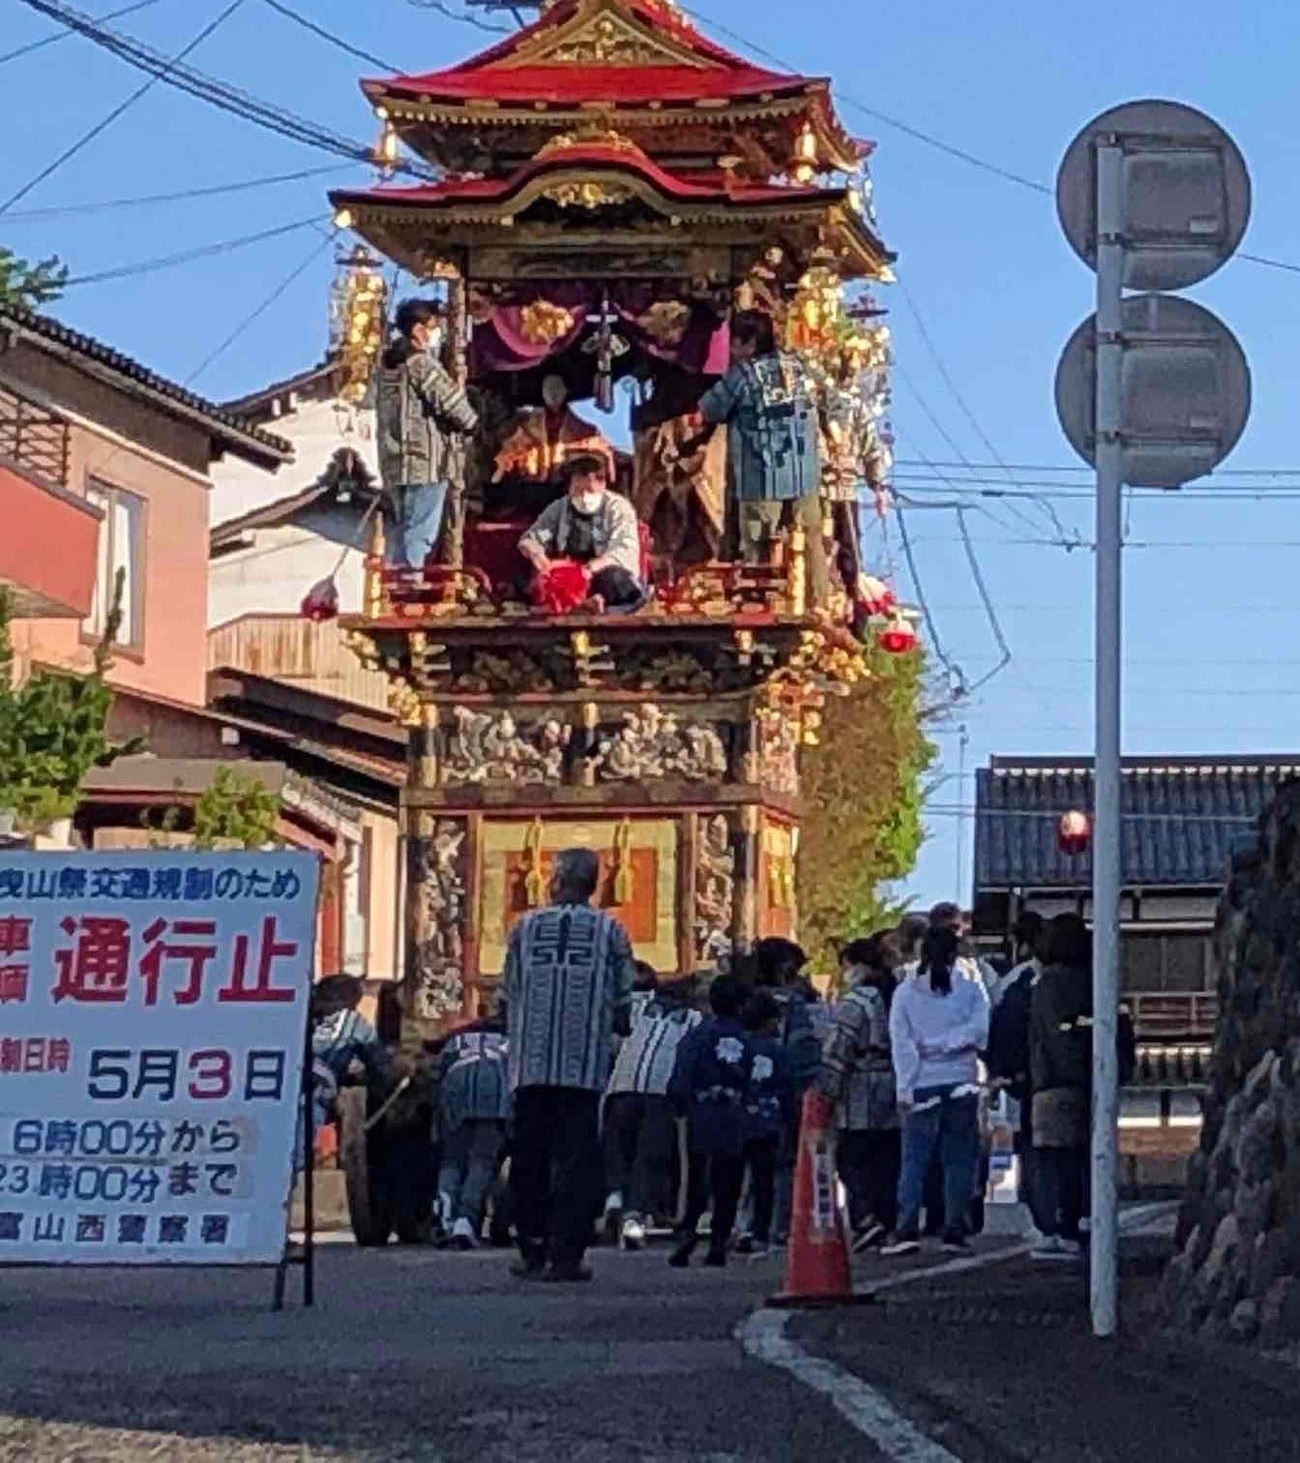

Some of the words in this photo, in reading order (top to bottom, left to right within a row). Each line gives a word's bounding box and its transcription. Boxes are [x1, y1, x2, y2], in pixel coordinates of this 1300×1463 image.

[51, 915, 298, 1007] 通行止
[87, 1048, 285, 1101] 5月3日
